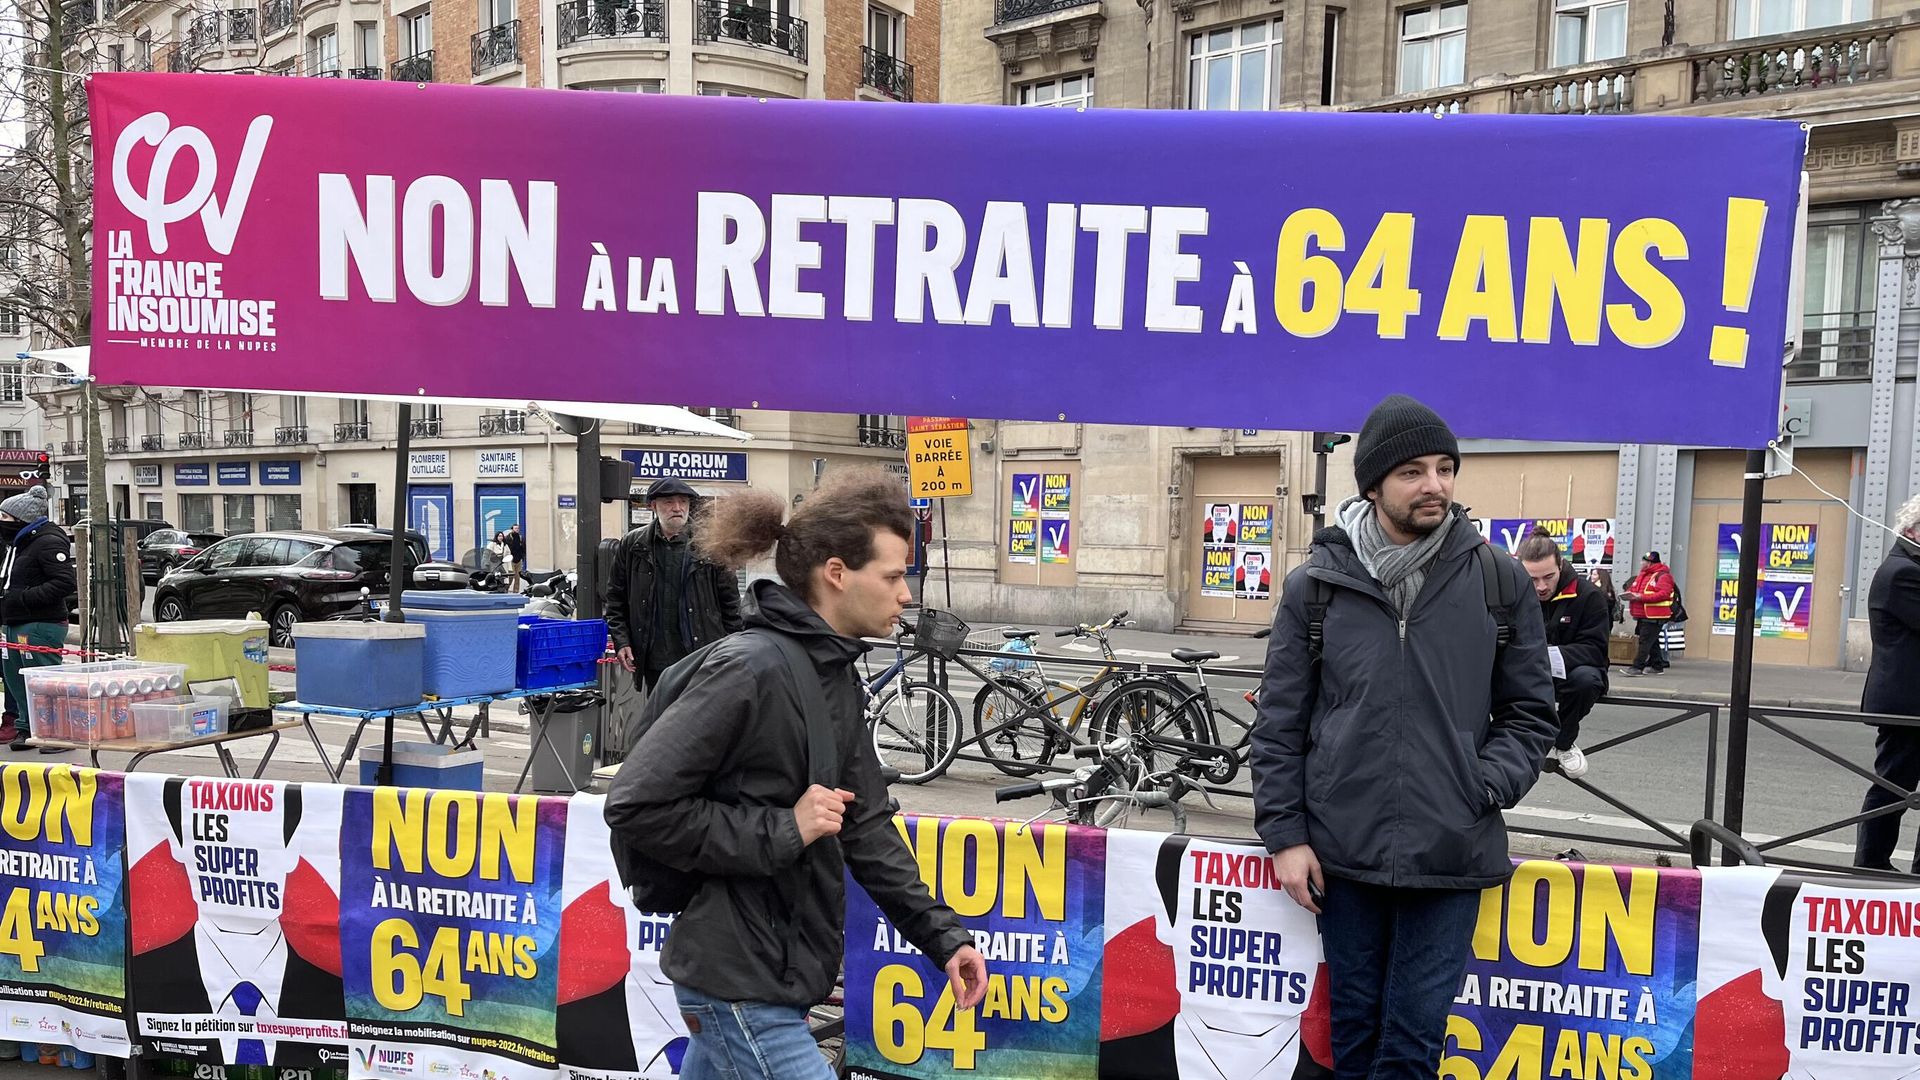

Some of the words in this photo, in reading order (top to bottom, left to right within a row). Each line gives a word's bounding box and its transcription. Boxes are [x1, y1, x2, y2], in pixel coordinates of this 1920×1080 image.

[108, 230, 133, 259] LA
[319, 173, 557, 309] NON
[582, 242, 616, 313] À
[627, 256, 679, 314] LA
[695, 191, 1209, 333] RETRAITE
[1220, 261, 1257, 334] À
[1274, 207, 1421, 339] 64
[1436, 214, 1689, 349] ANS
[108, 260, 223, 298] FRANCE
[108, 297, 276, 336] INSOUMISE
[141, 338, 190, 349] MEMBRE
[197, 339, 212, 350] DE
[218, 340, 231, 350] LA
[238, 341, 277, 352] NUPES
[925, 438, 952, 449] VOIE
[411, 454, 446, 464] PLOMBERIE
[480, 452, 516, 463] SANITAIRE
[641, 452, 664, 468] AU
[669, 453, 728, 469] FORUM
[915, 450, 962, 462] BARRÉE
[412, 465, 446, 474] OUTILLAGE
[479, 463, 519, 474] CHAUFFAGE
[640, 469, 659, 477] DU
[663, 469, 728, 478] BATIMENT
[884, 464, 908, 474] SANITA
[0, 478, 28, 486] AVANE
[921, 481, 946, 491] 200
[1046, 475, 1066, 488] NON
[1167, 486, 1180, 495] 95
[1044, 494, 1057, 507] 64
[1276, 487, 1288, 496] 95
[1243, 505, 1268, 520] NON
[1012, 520, 1032, 533] NON
[1241, 526, 1256, 540] 64
[1772, 525, 1809, 543] NON
[1011, 539, 1024, 552] 64
[1207, 551, 1231, 565] NON
[1769, 550, 1792, 568] 64
[1792, 551, 1808, 560] ANS
[1205, 572, 1220, 585] 64
[0, 762, 98, 847] ON
[189, 781, 274, 812] TAXONS
[192, 813, 229, 842] LES
[371, 786, 540, 884] NON
[84, 855, 97, 885] À
[195, 846, 259, 877] SUPER
[1191, 850, 1282, 891] TAXON
[198, 875, 280, 910] PROFITS
[371, 876, 388, 909] À
[390, 881, 413, 910] LA
[417, 888, 517, 923] RETRAITE
[522, 892, 538, 925] À
[1193, 888, 1243, 924] LES
[0, 887, 44, 972] 4
[37, 891, 99, 936] ANS
[873, 918, 890, 952] À
[1051, 931, 1069, 965] À
[1190, 925, 1282, 966] SUPER
[1806, 937, 1865, 975] LES
[370, 918, 471, 1017] 64
[466, 930, 538, 980] ANS
[1189, 961, 1307, 1004] PROFITS
[35, 990, 48, 998] sur
[1488, 976, 1629, 1021] RETRAITE
[1635, 987, 1657, 1025] À
[1803, 977, 1910, 1017] SUPER
[872, 964, 986, 1070] 64
[982, 976, 1069, 1023] ANS
[147, 1018, 179, 1033] Signez
[181, 1019, 192, 1031] la
[195, 1018, 235, 1034] pétition
[237, 1022, 254, 1033] sur
[256, 1021, 349, 1039] taxesuperprofits.fr
[351, 1024, 393, 1037] Rejoignez
[394, 1025, 403, 1036] la
[404, 1027, 457, 1041] mobilisation
[457, 1034, 470, 1044] sur
[471, 1036, 556, 1064] nupes-2022.fr/retraites
[379, 1050, 414, 1066] NUPES
[1549, 1028, 1656, 1080] ANS
